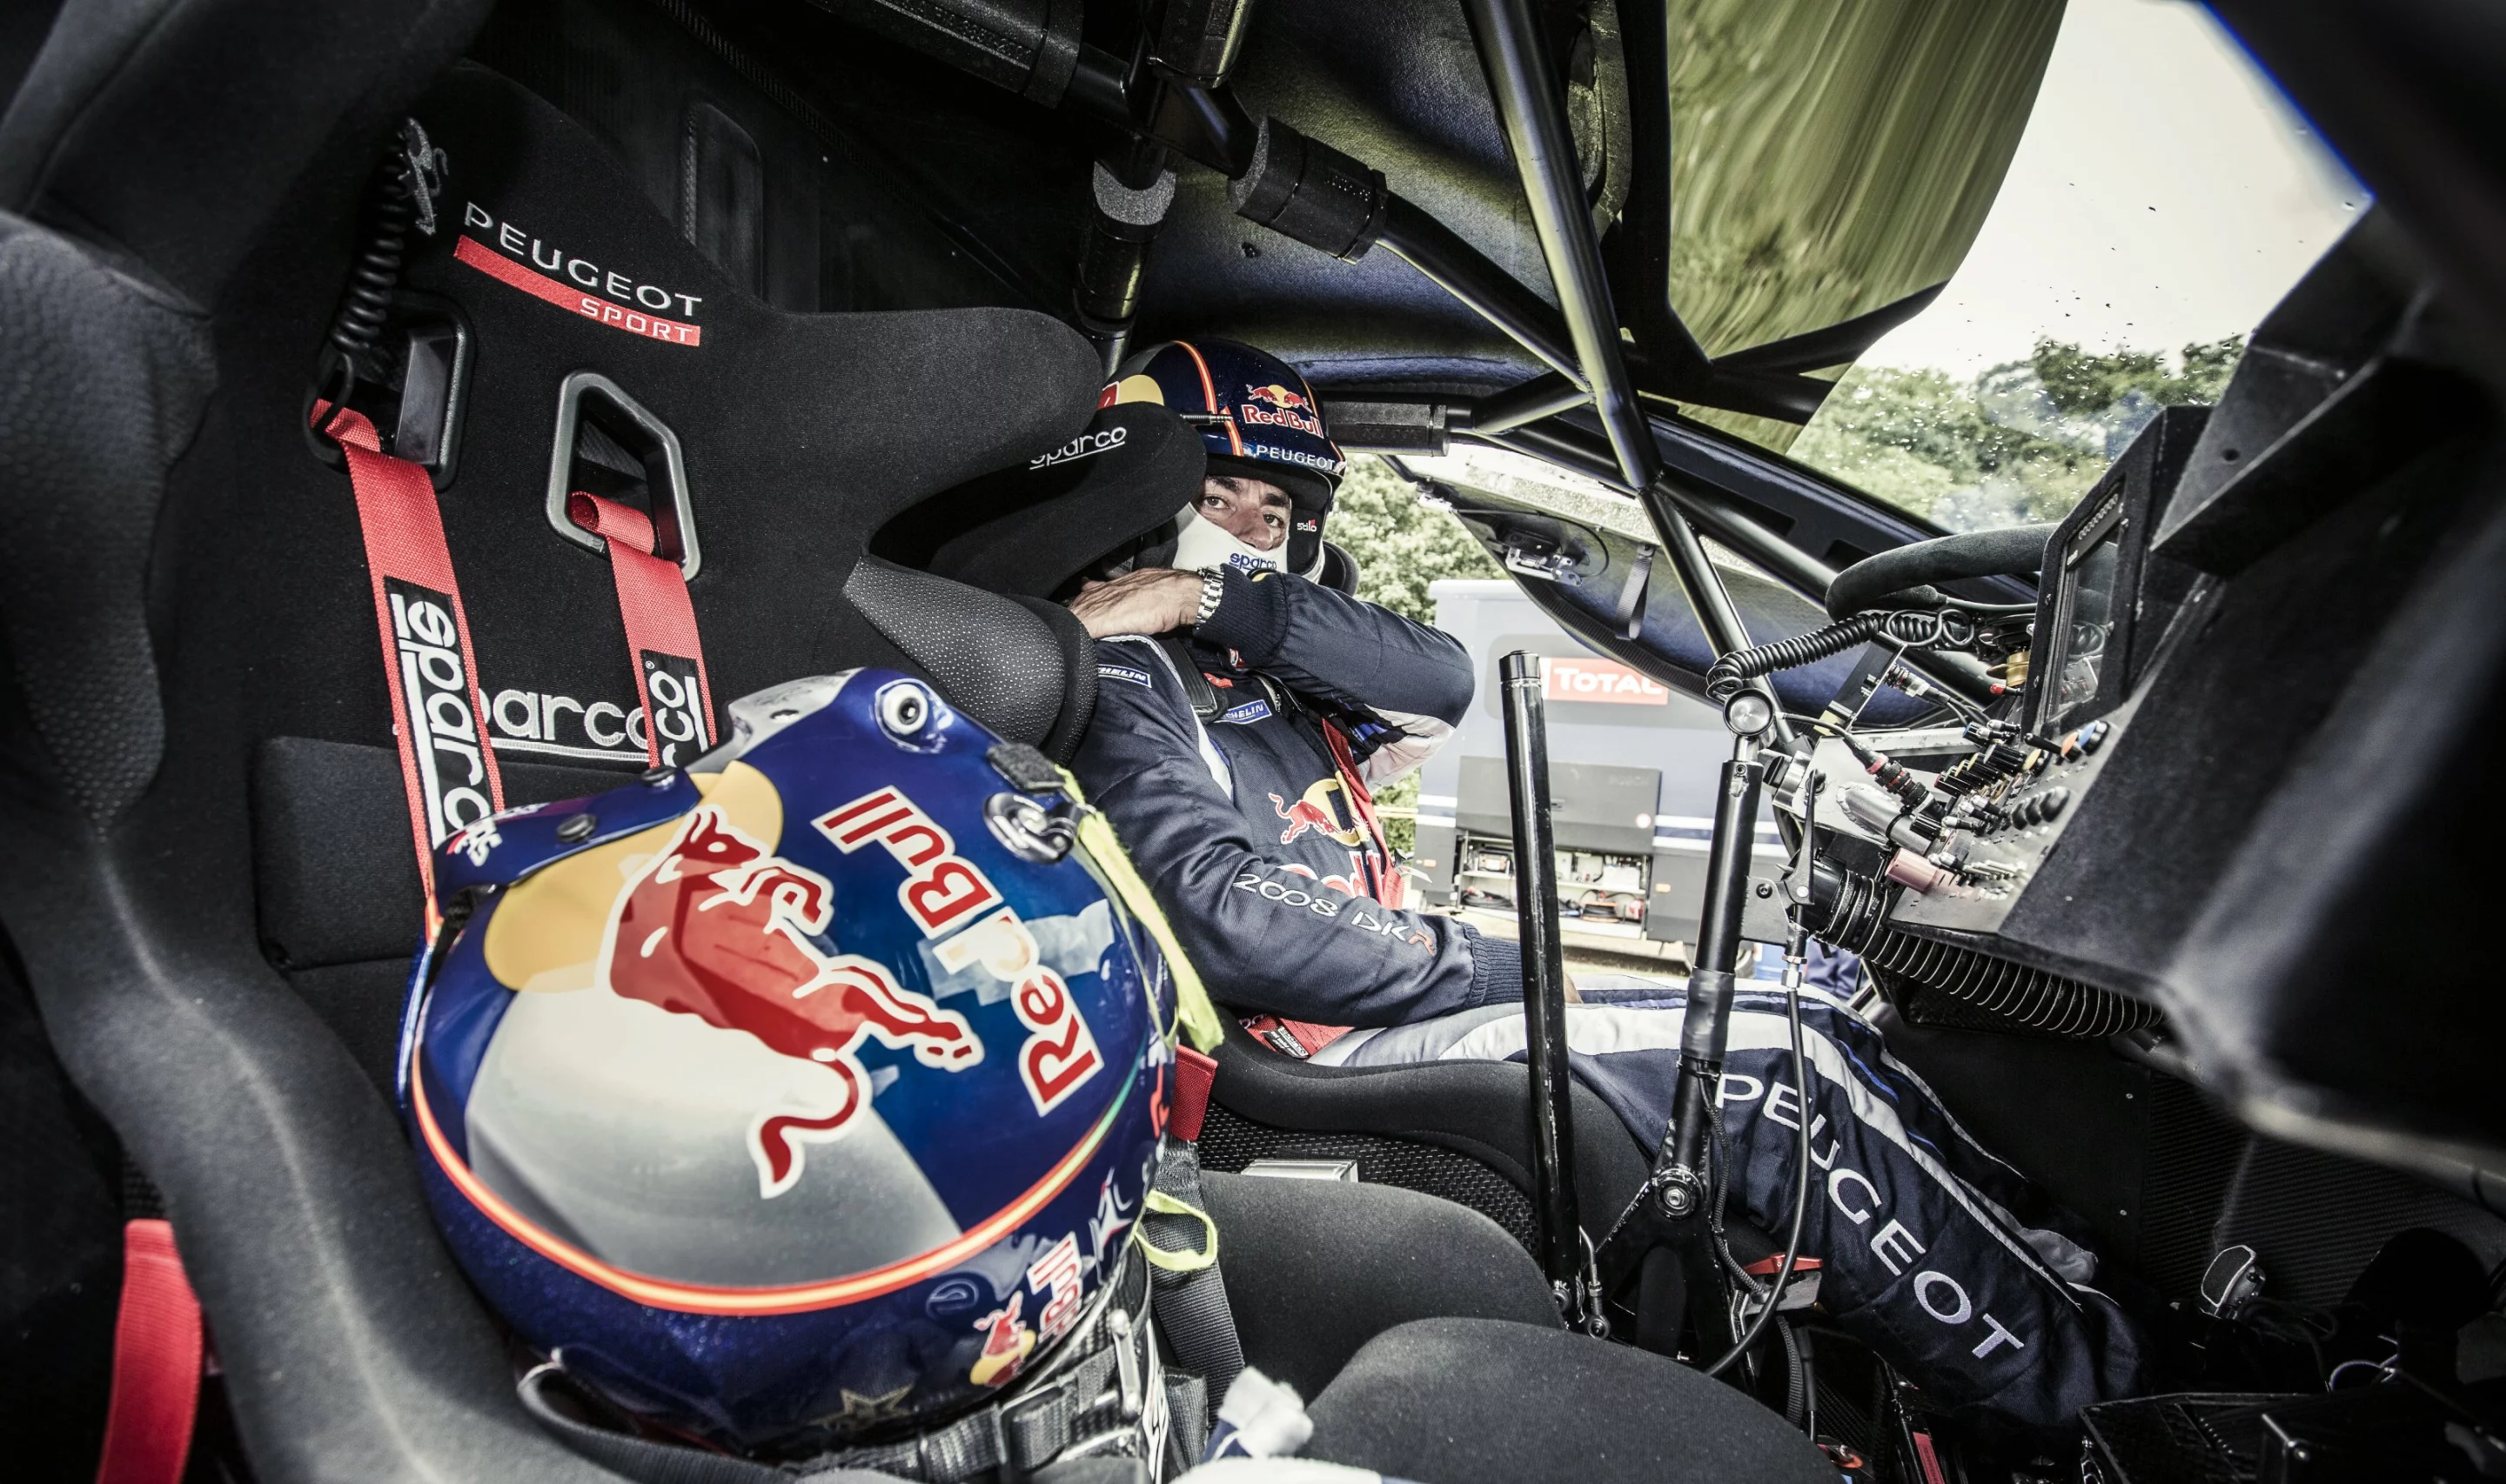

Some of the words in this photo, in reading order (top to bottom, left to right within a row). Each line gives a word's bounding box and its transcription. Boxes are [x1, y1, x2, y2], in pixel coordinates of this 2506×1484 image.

[465, 202, 702, 316] PEUGEOT
[580, 297, 694, 344] SPORT
[1242, 404, 1289, 427] Red
[1285, 410, 1323, 438] Bull
[1256, 445, 1335, 471] PEUGEOT
[1230, 553, 1277, 570] sparco
[1098, 667, 1146, 681] HELIN
[1553, 667, 1663, 695] TOTAL
[399, 598, 490, 831] sparc
[478, 687, 648, 751] arco
[1223, 704, 1263, 719] CHELIN
[811, 785, 1003, 940] Bull
[1232, 873, 1339, 918] 2008
[933, 906, 1103, 1117] Red
[1715, 1073, 2024, 1359] PEUGEOT
